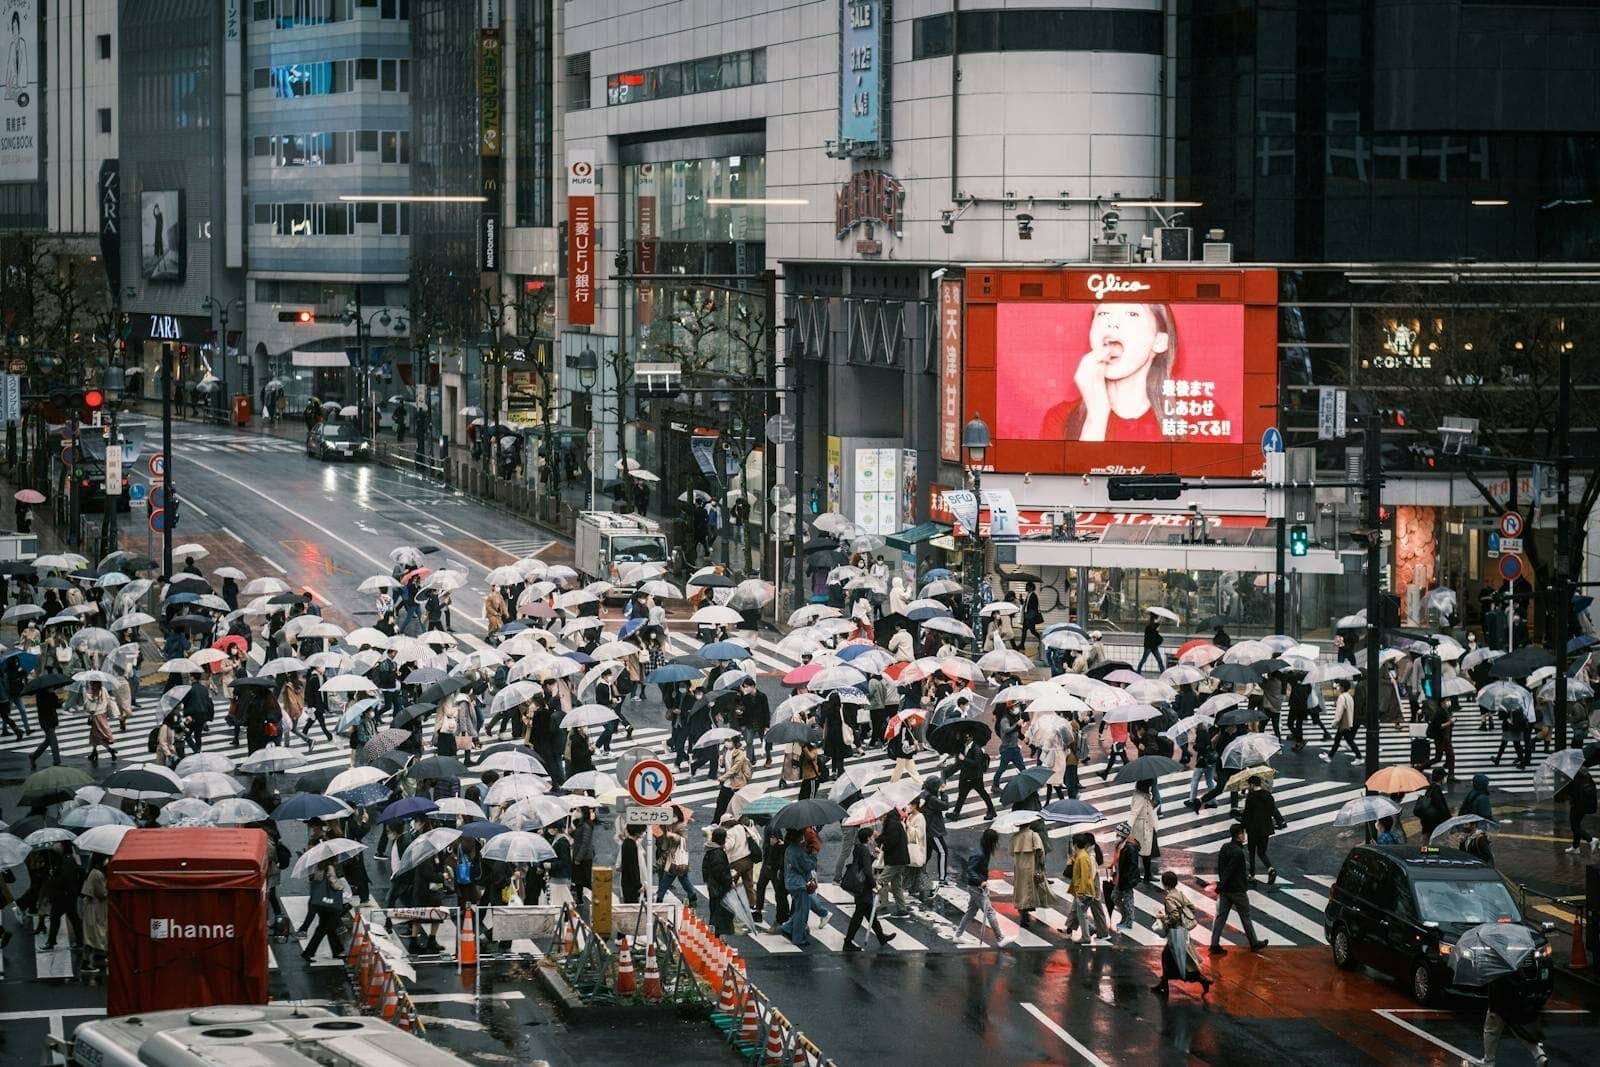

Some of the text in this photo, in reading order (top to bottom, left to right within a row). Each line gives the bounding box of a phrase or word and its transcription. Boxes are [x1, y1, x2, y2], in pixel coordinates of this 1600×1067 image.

[850, 4, 872, 28] SALE
[1, 136, 34, 151] SONGBOOK
[103, 171, 117, 235] ZARA
[486, 218, 494, 268] McDonald's
[575, 207, 589, 302] 三菱UFJ銀行
[1087, 273, 1151, 300] Glico
[150, 315, 181, 339] ZARA
[945, 308, 957, 454] 天津甘栗
[1162, 379, 1216, 398] 最後まで
[1164, 399, 1215, 416] しあわせ
[630, 811, 669, 822] ここから
